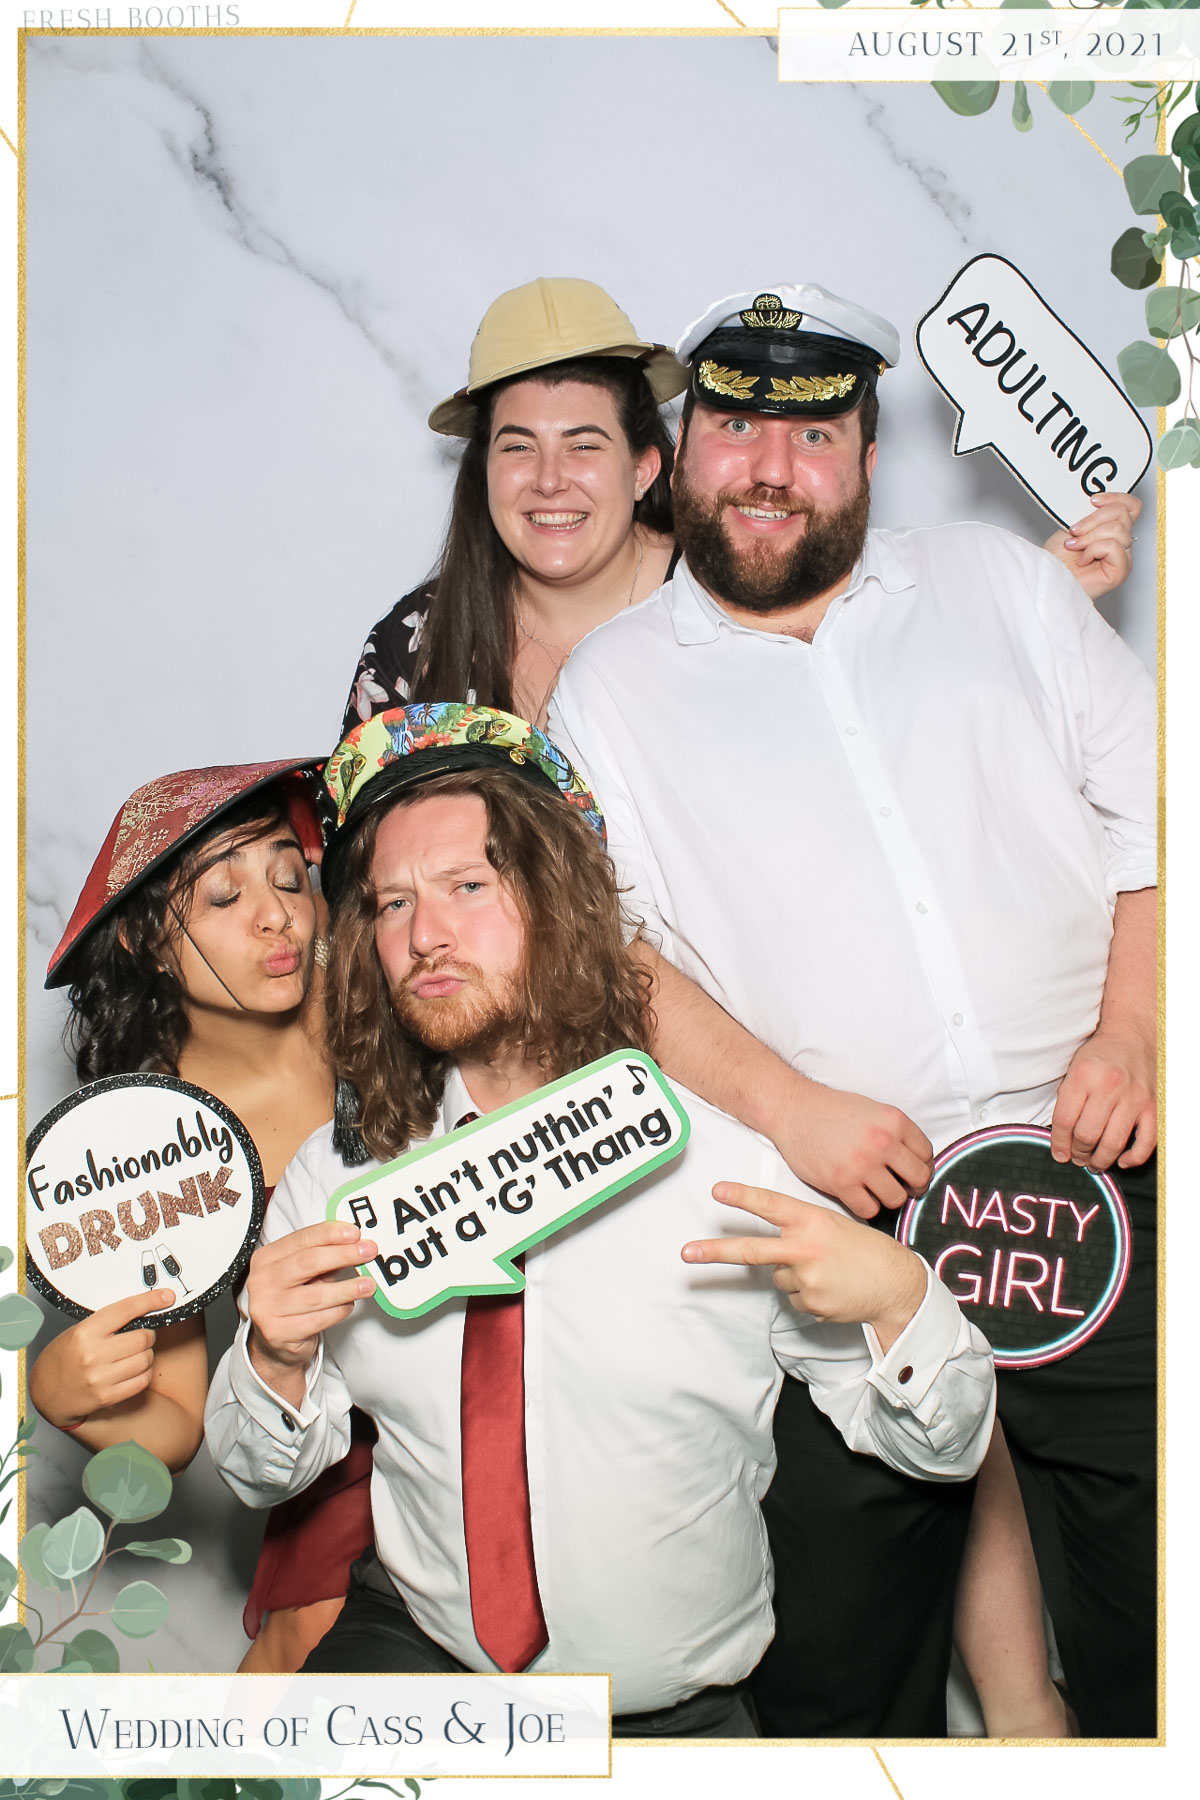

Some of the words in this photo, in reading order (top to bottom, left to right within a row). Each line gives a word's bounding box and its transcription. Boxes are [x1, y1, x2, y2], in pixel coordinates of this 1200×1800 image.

[947, 302, 1118, 498] ADULTING
[27, 1110, 234, 1212] Fashionably
[375, 1226, 449, 1287] but
[455, 1210, 488, 1242] a
[543, 1107, 673, 1190] Thang
[392, 1159, 484, 1236] Ain't
[487, 1084, 614, 1180] nuthin'
[38, 1165, 242, 1271] DRUNK
[940, 1184, 1100, 1243] NASTY
[934, 1244, 1086, 1317] GIRL
